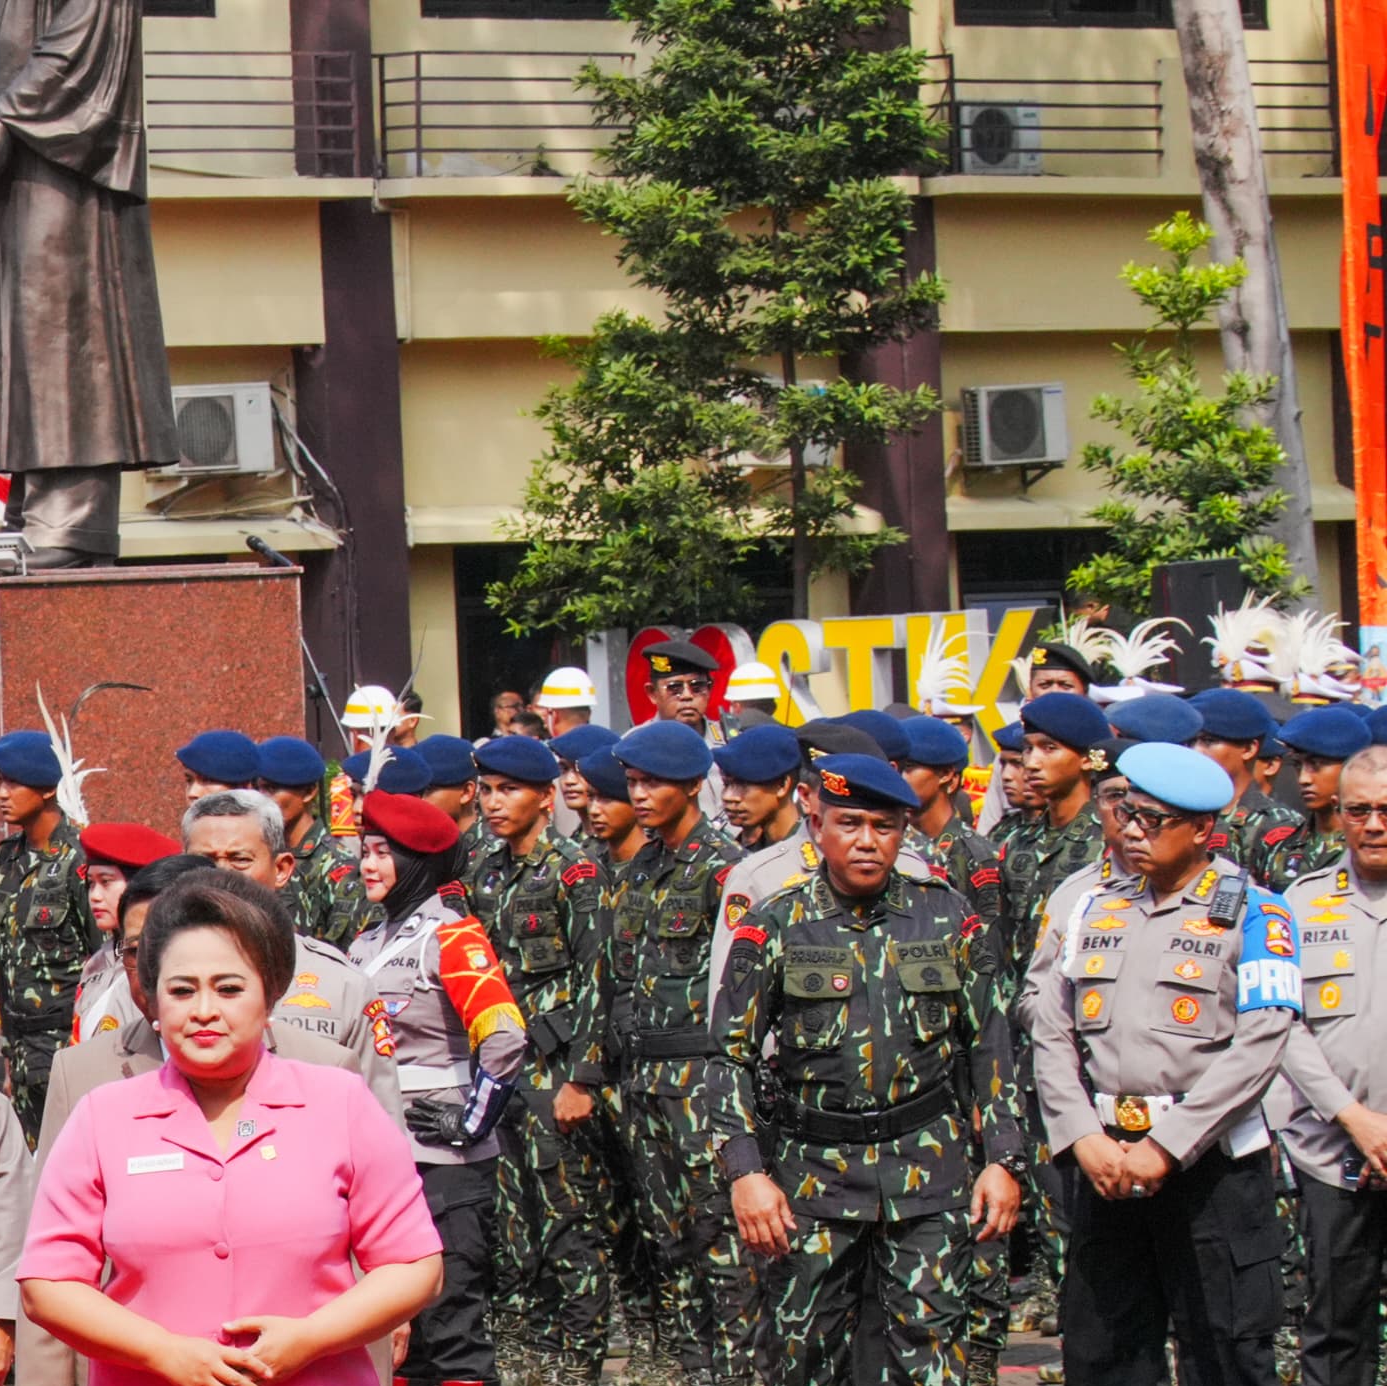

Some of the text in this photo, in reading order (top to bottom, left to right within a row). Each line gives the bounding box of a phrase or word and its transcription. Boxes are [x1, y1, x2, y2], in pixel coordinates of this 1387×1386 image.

[1082, 935, 1124, 950] BENY
[1302, 931, 1351, 945] RIZAL
[898, 943, 949, 961] POLRI
[1170, 937, 1223, 957] POLRI
